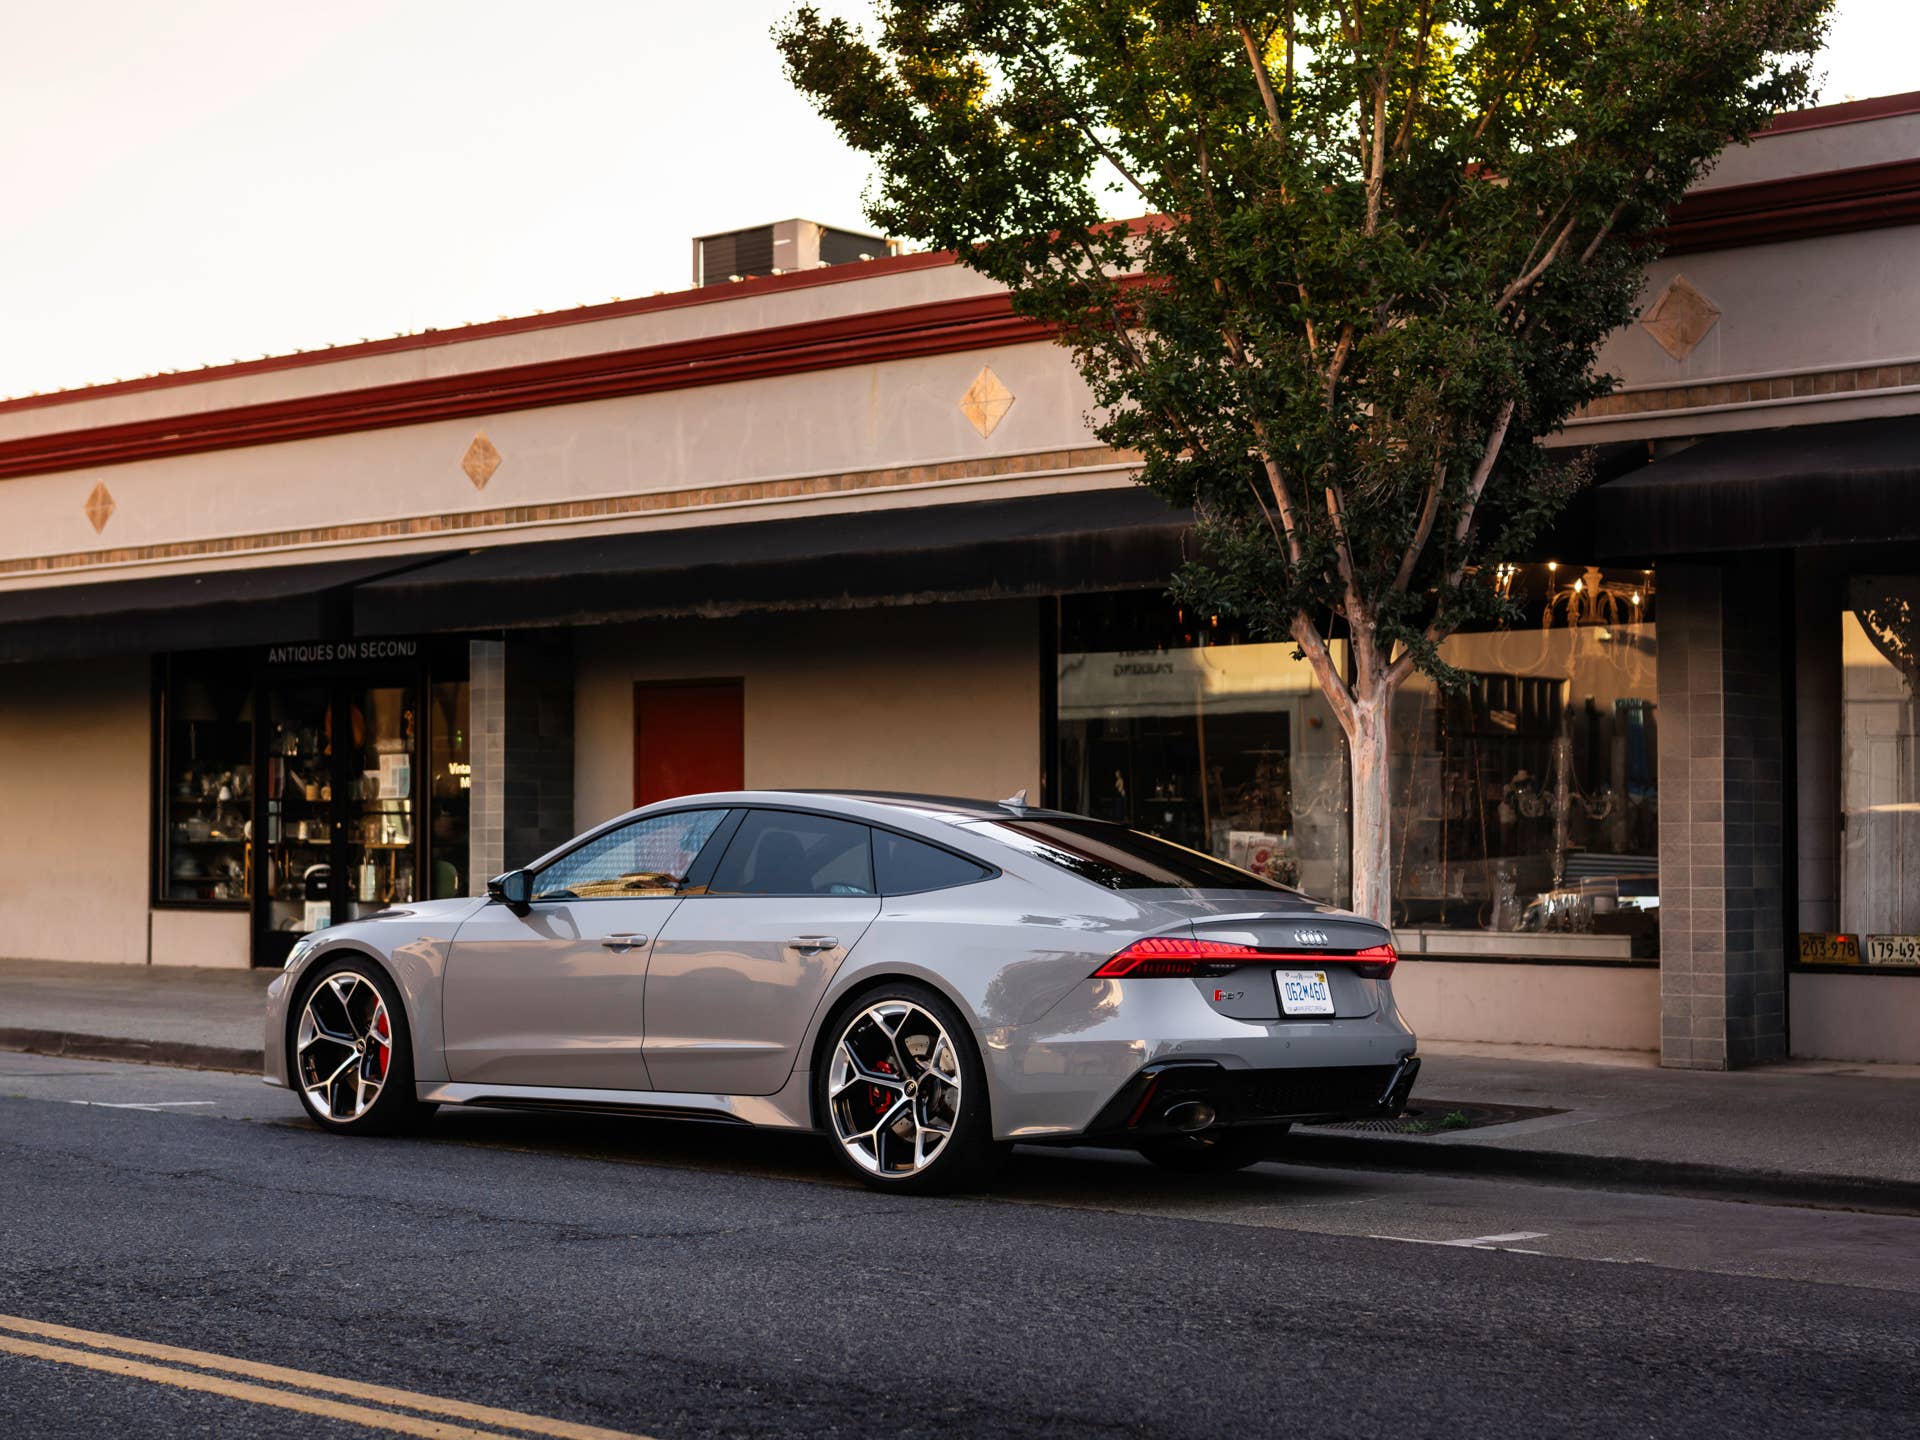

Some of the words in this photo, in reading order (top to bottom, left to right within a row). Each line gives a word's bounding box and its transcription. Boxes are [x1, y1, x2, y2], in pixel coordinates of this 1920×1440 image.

[268, 644, 334, 663] ANTIQUES
[337, 643, 357, 660] ON
[360, 641, 417, 659] SECOND
[1285, 982, 1326, 1001] 062M460
